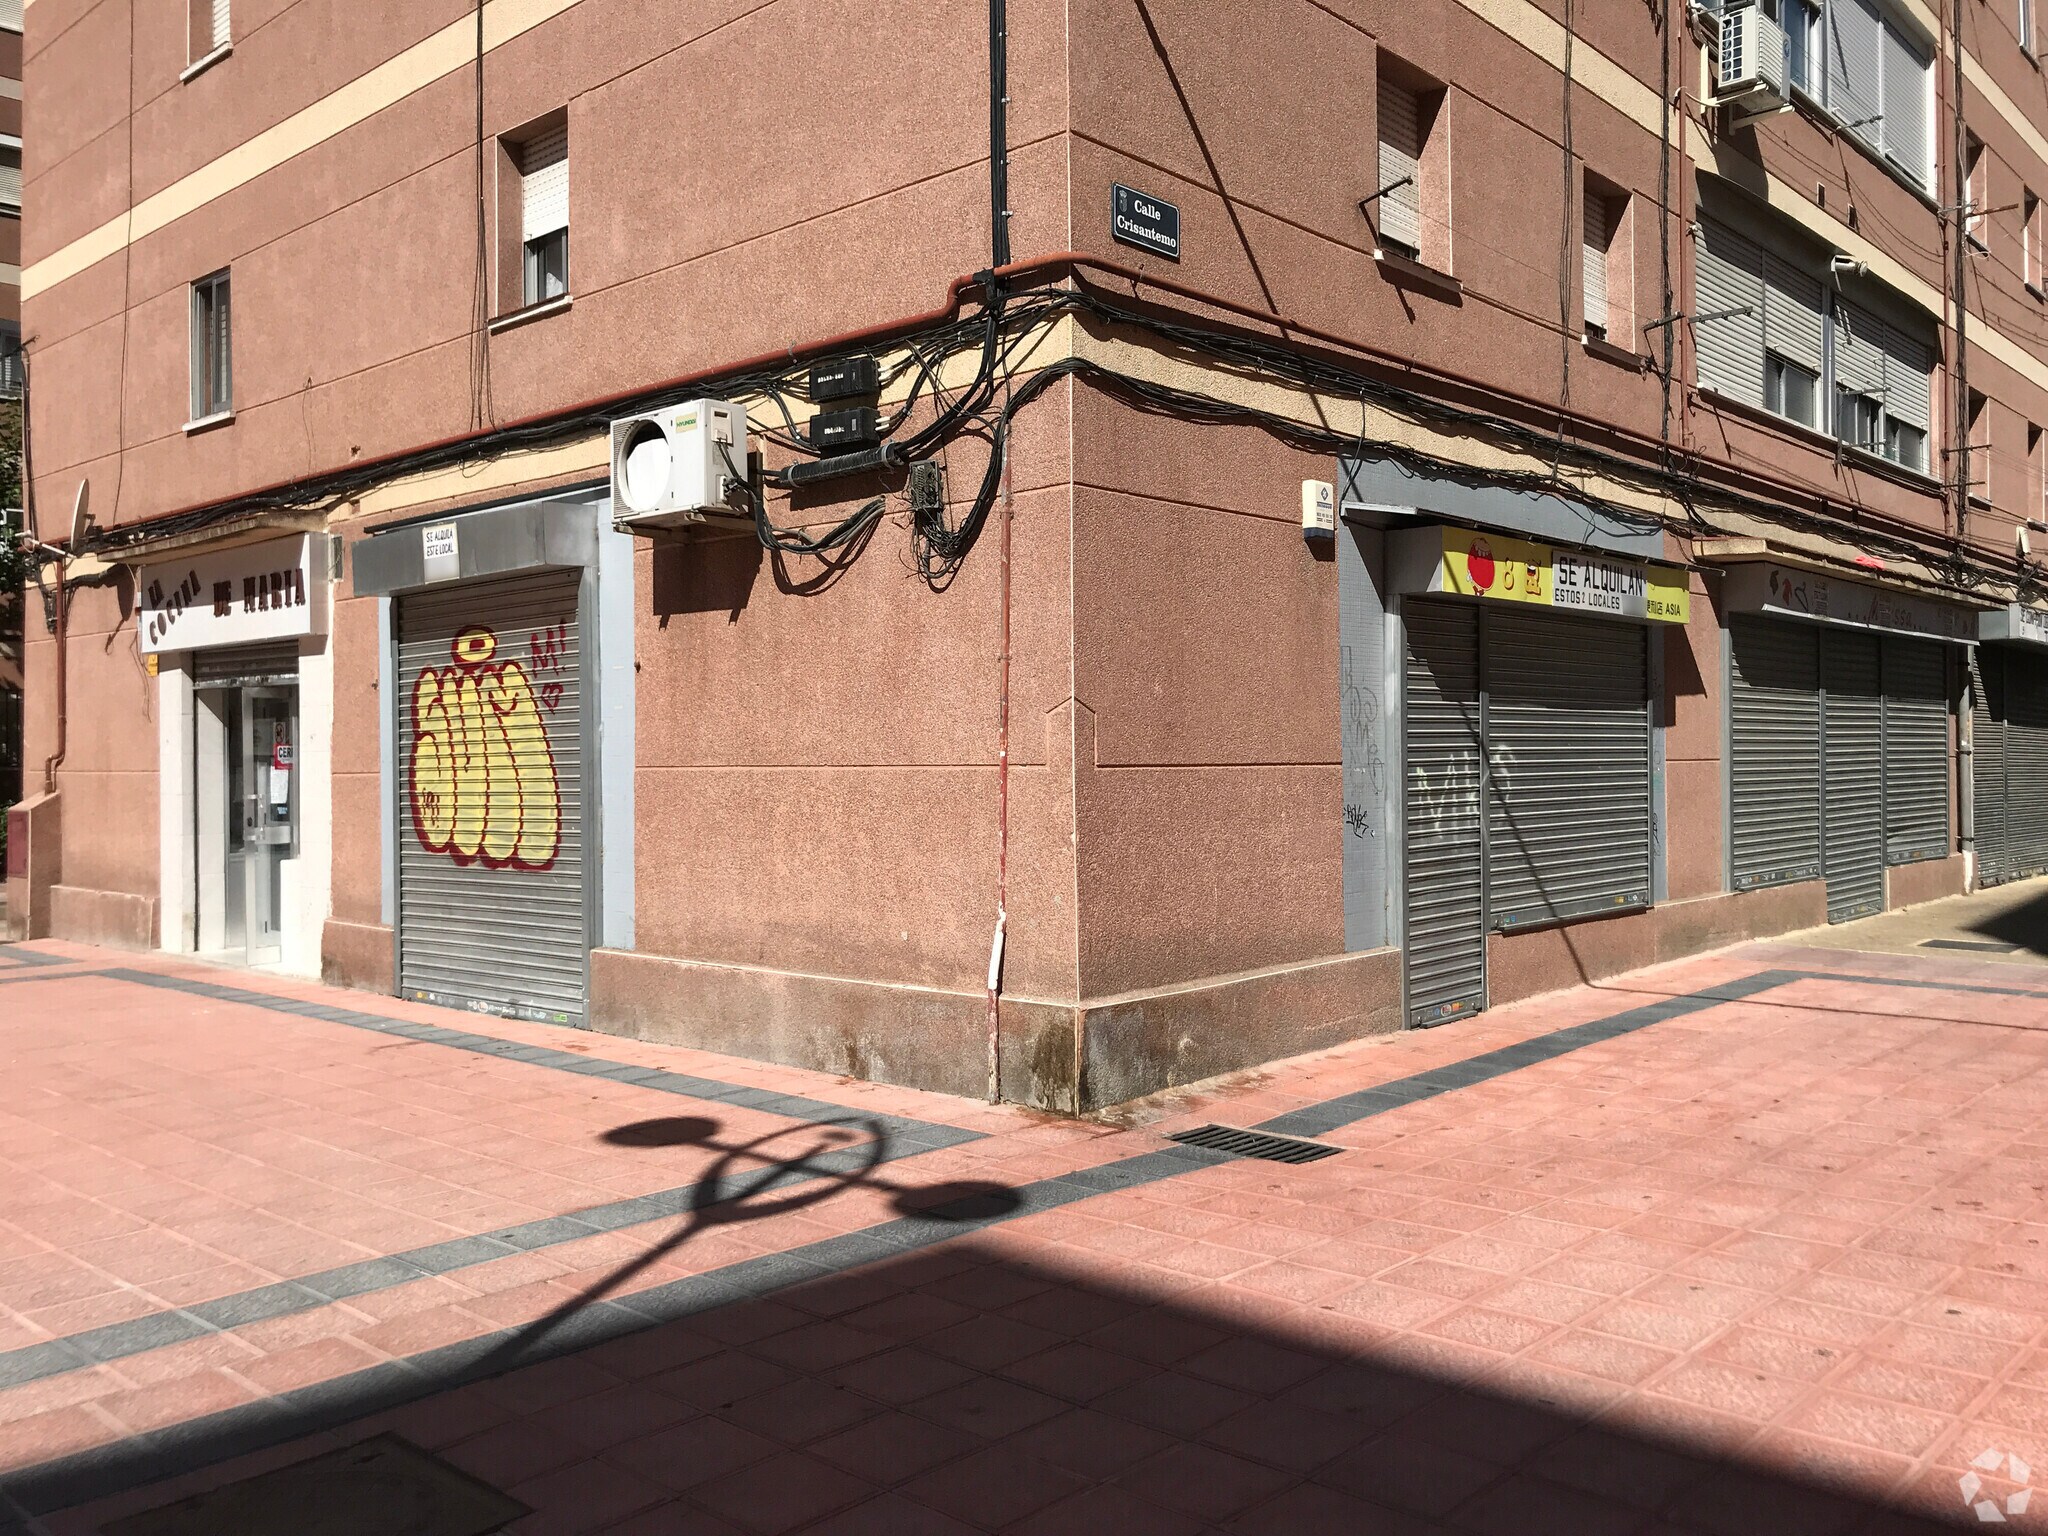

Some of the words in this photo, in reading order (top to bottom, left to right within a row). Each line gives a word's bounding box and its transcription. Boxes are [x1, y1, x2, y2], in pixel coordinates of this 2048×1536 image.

[1134, 200, 1161, 221] Calle
[1117, 215, 1177, 248] Crisantemo
[426, 532, 433, 543] SE
[435, 528, 453, 541] ALQUILA
[427, 545, 438, 557] ESTE
[440, 542, 454, 555] LOCAL
[1559, 556, 1577, 587] SE
[1584, 560, 1643, 597] ALQUILAN
[213, 580, 232, 617] DE
[243, 568, 306, 614] MARIA
[1555, 588, 1580, 604] ESTOS
[1588, 593, 1620, 610] LOCALES
[149, 569, 201, 646] COCINA
[1665, 603, 1681, 616] ASIA
